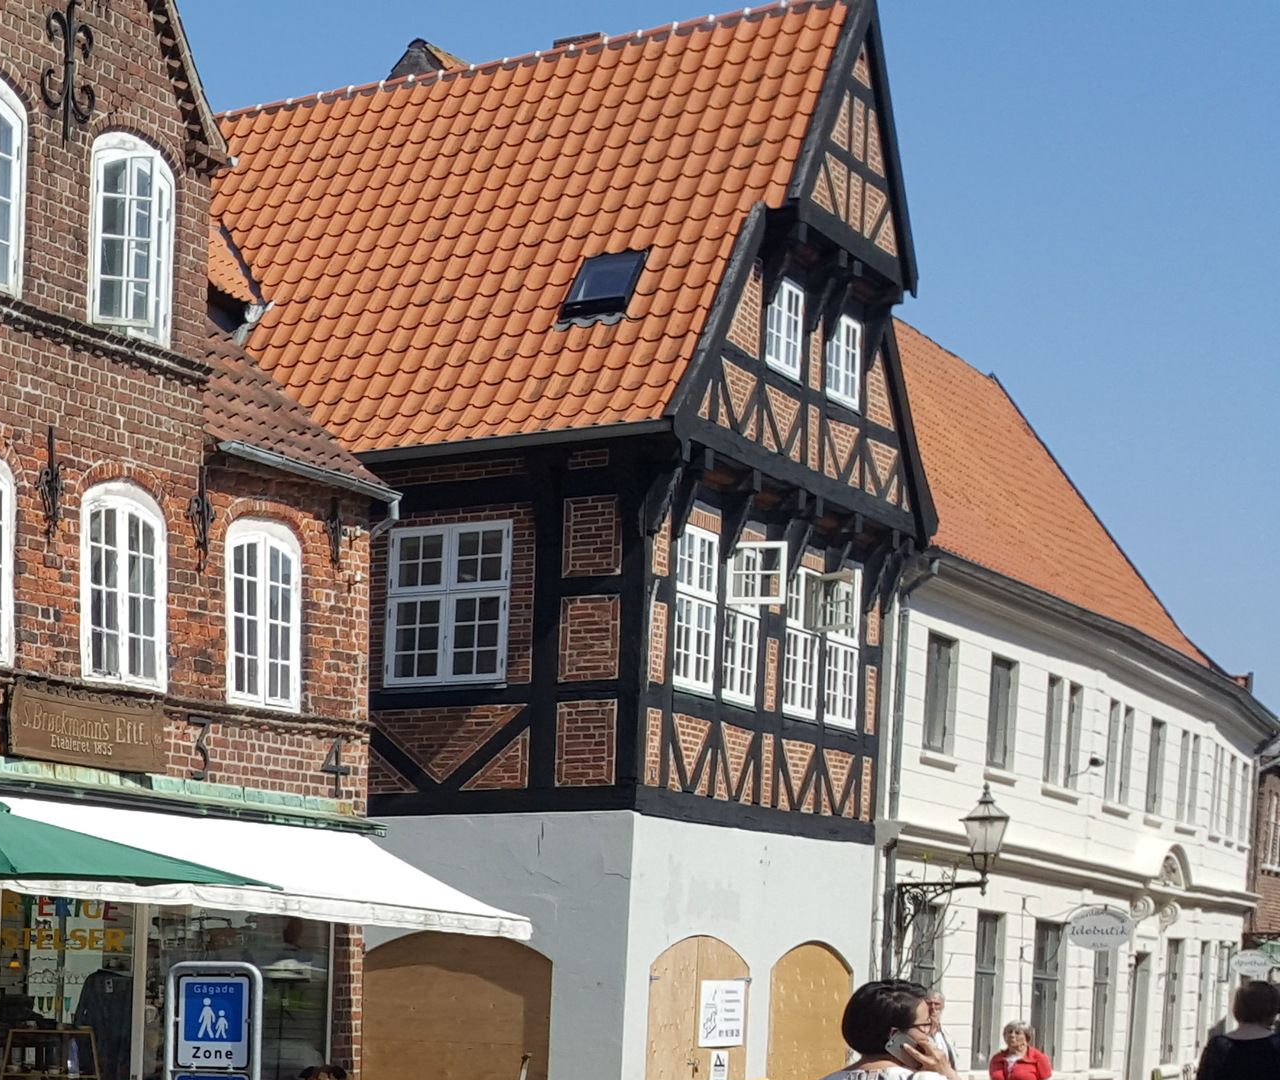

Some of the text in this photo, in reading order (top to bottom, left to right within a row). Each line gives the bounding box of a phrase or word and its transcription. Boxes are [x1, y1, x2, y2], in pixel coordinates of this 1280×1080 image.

[50, 734, 90, 753] Etableret
[194, 985, 234, 995] Gågade
[192, 1046, 233, 1059] Zone
